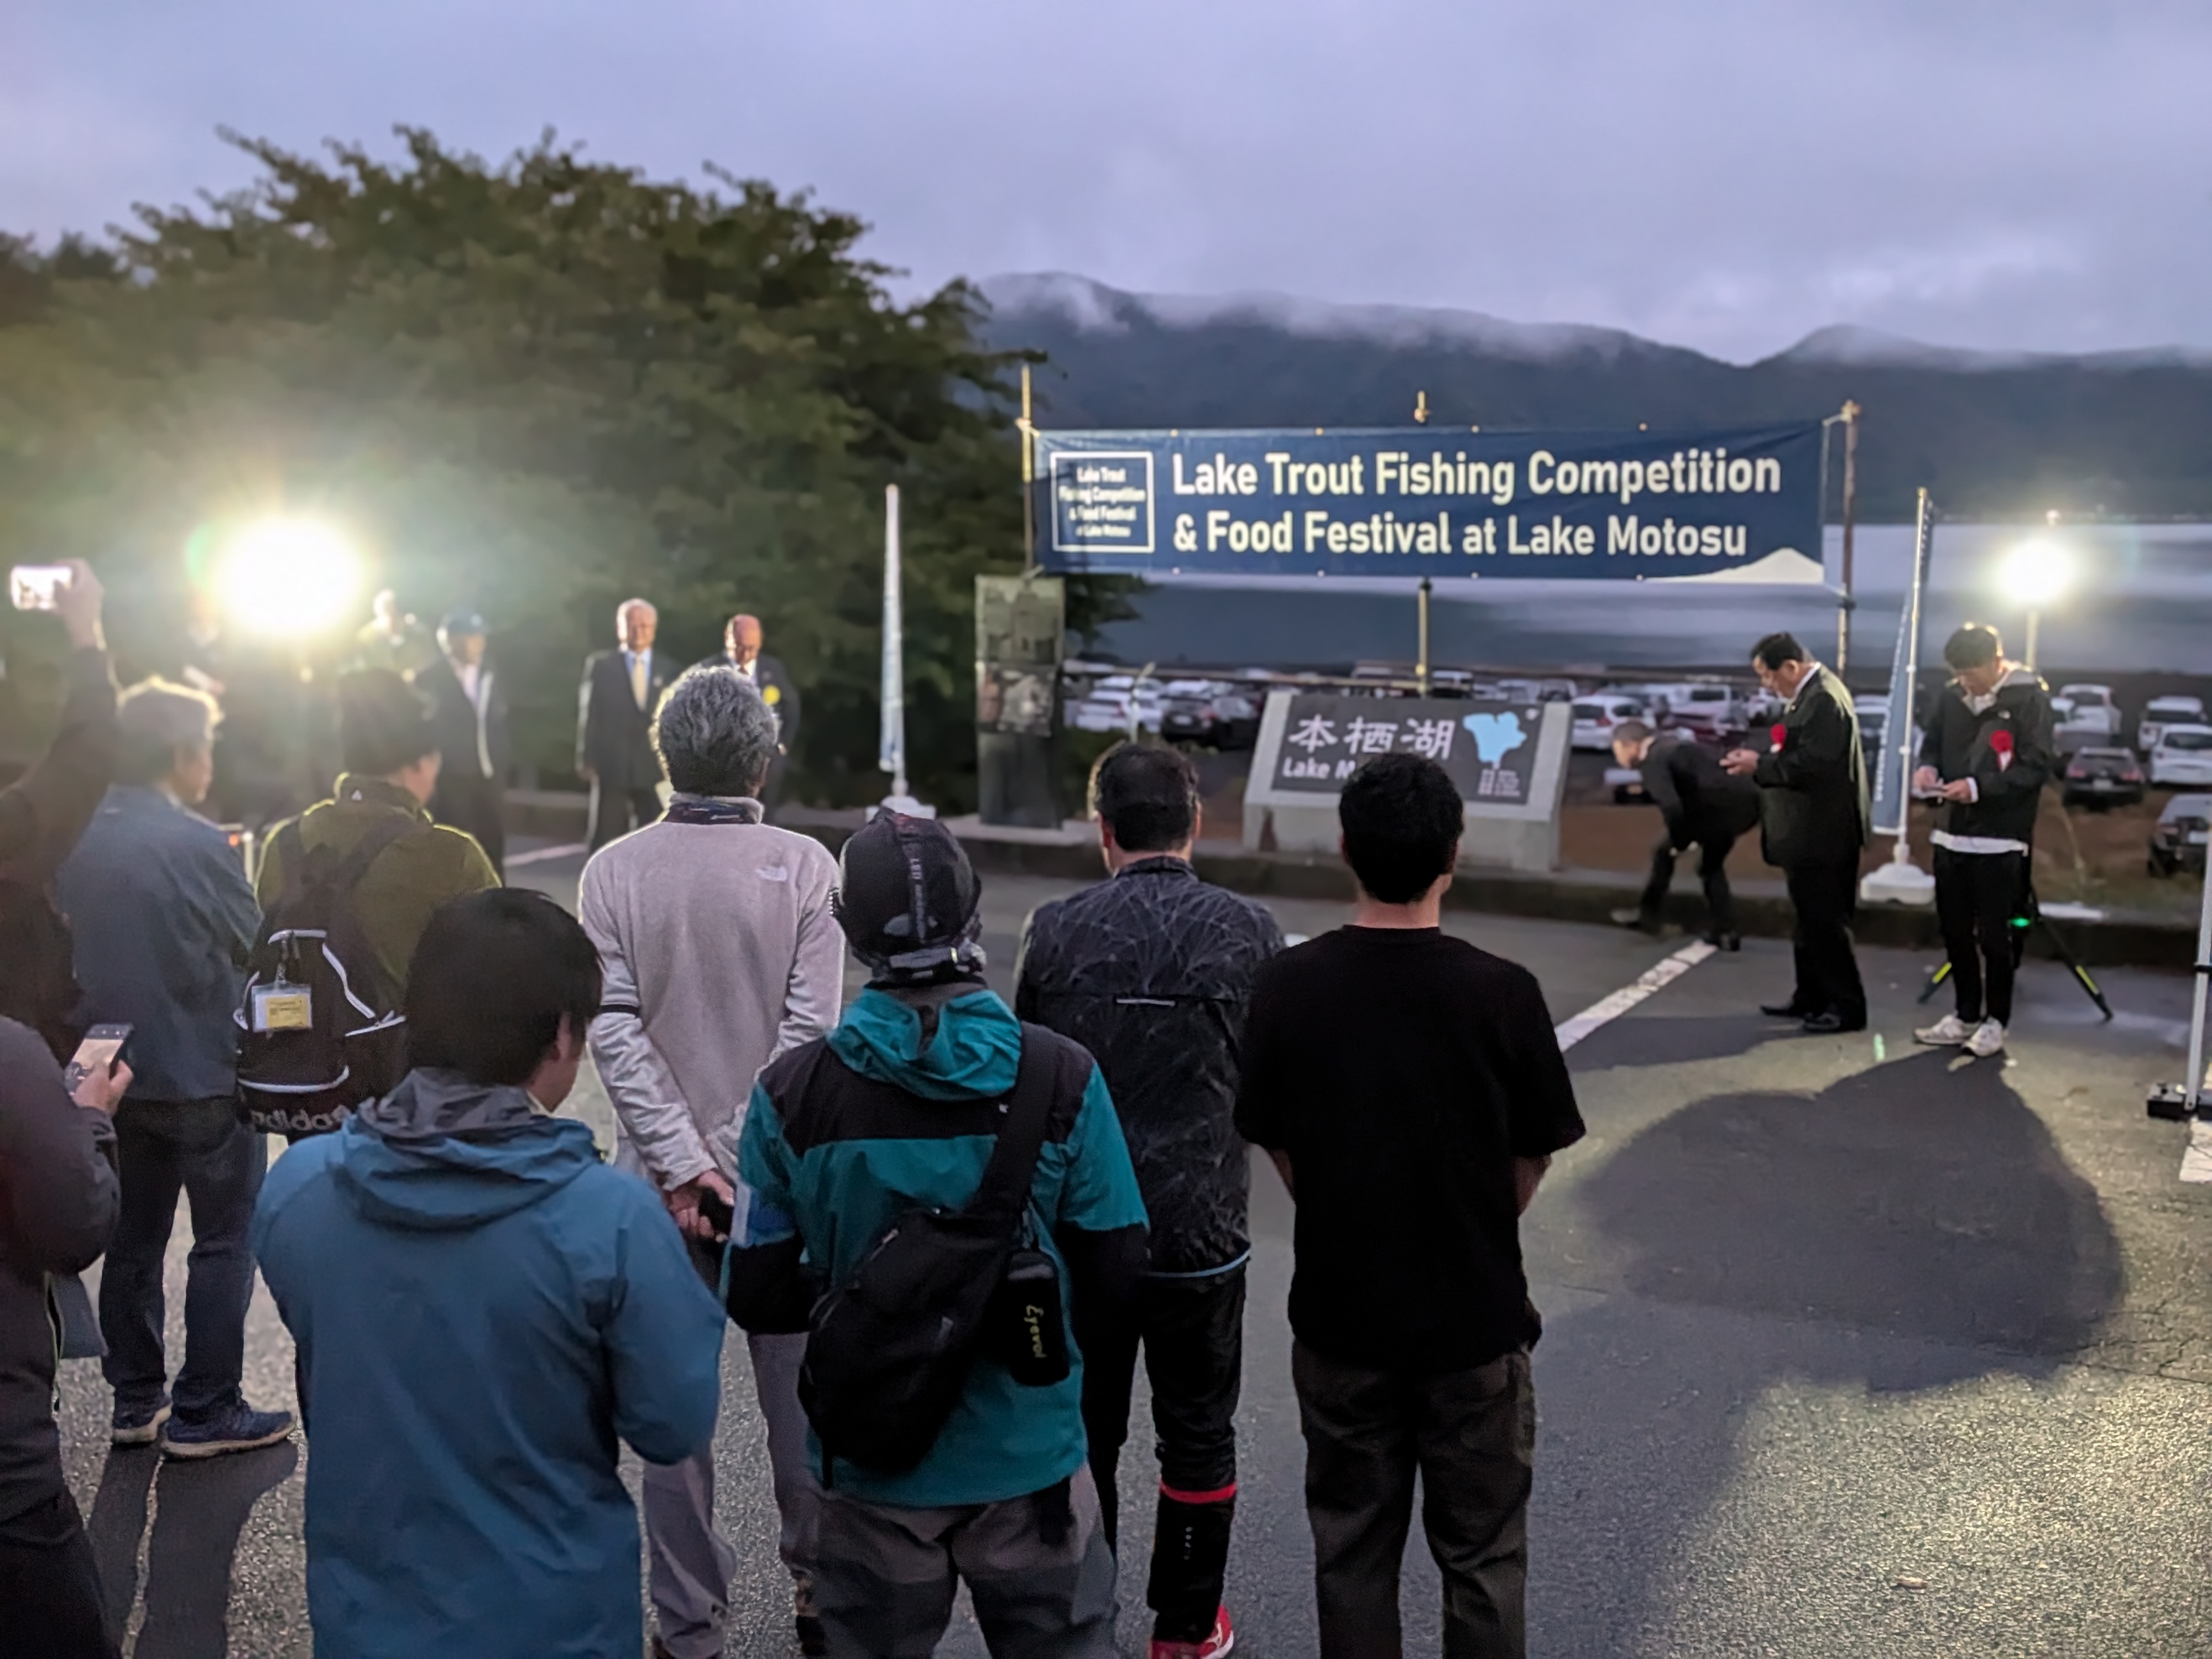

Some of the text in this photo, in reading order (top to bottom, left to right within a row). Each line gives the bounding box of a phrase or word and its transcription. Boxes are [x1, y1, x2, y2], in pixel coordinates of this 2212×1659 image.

[1172, 448, 1781, 505] Lake Trout Fishing Competition
[1173, 510, 1746, 555] & Food Festival at Lake Motosu
[1288, 714, 1455, 760] 本栖湖
[1282, 756, 1331, 779] Lake
